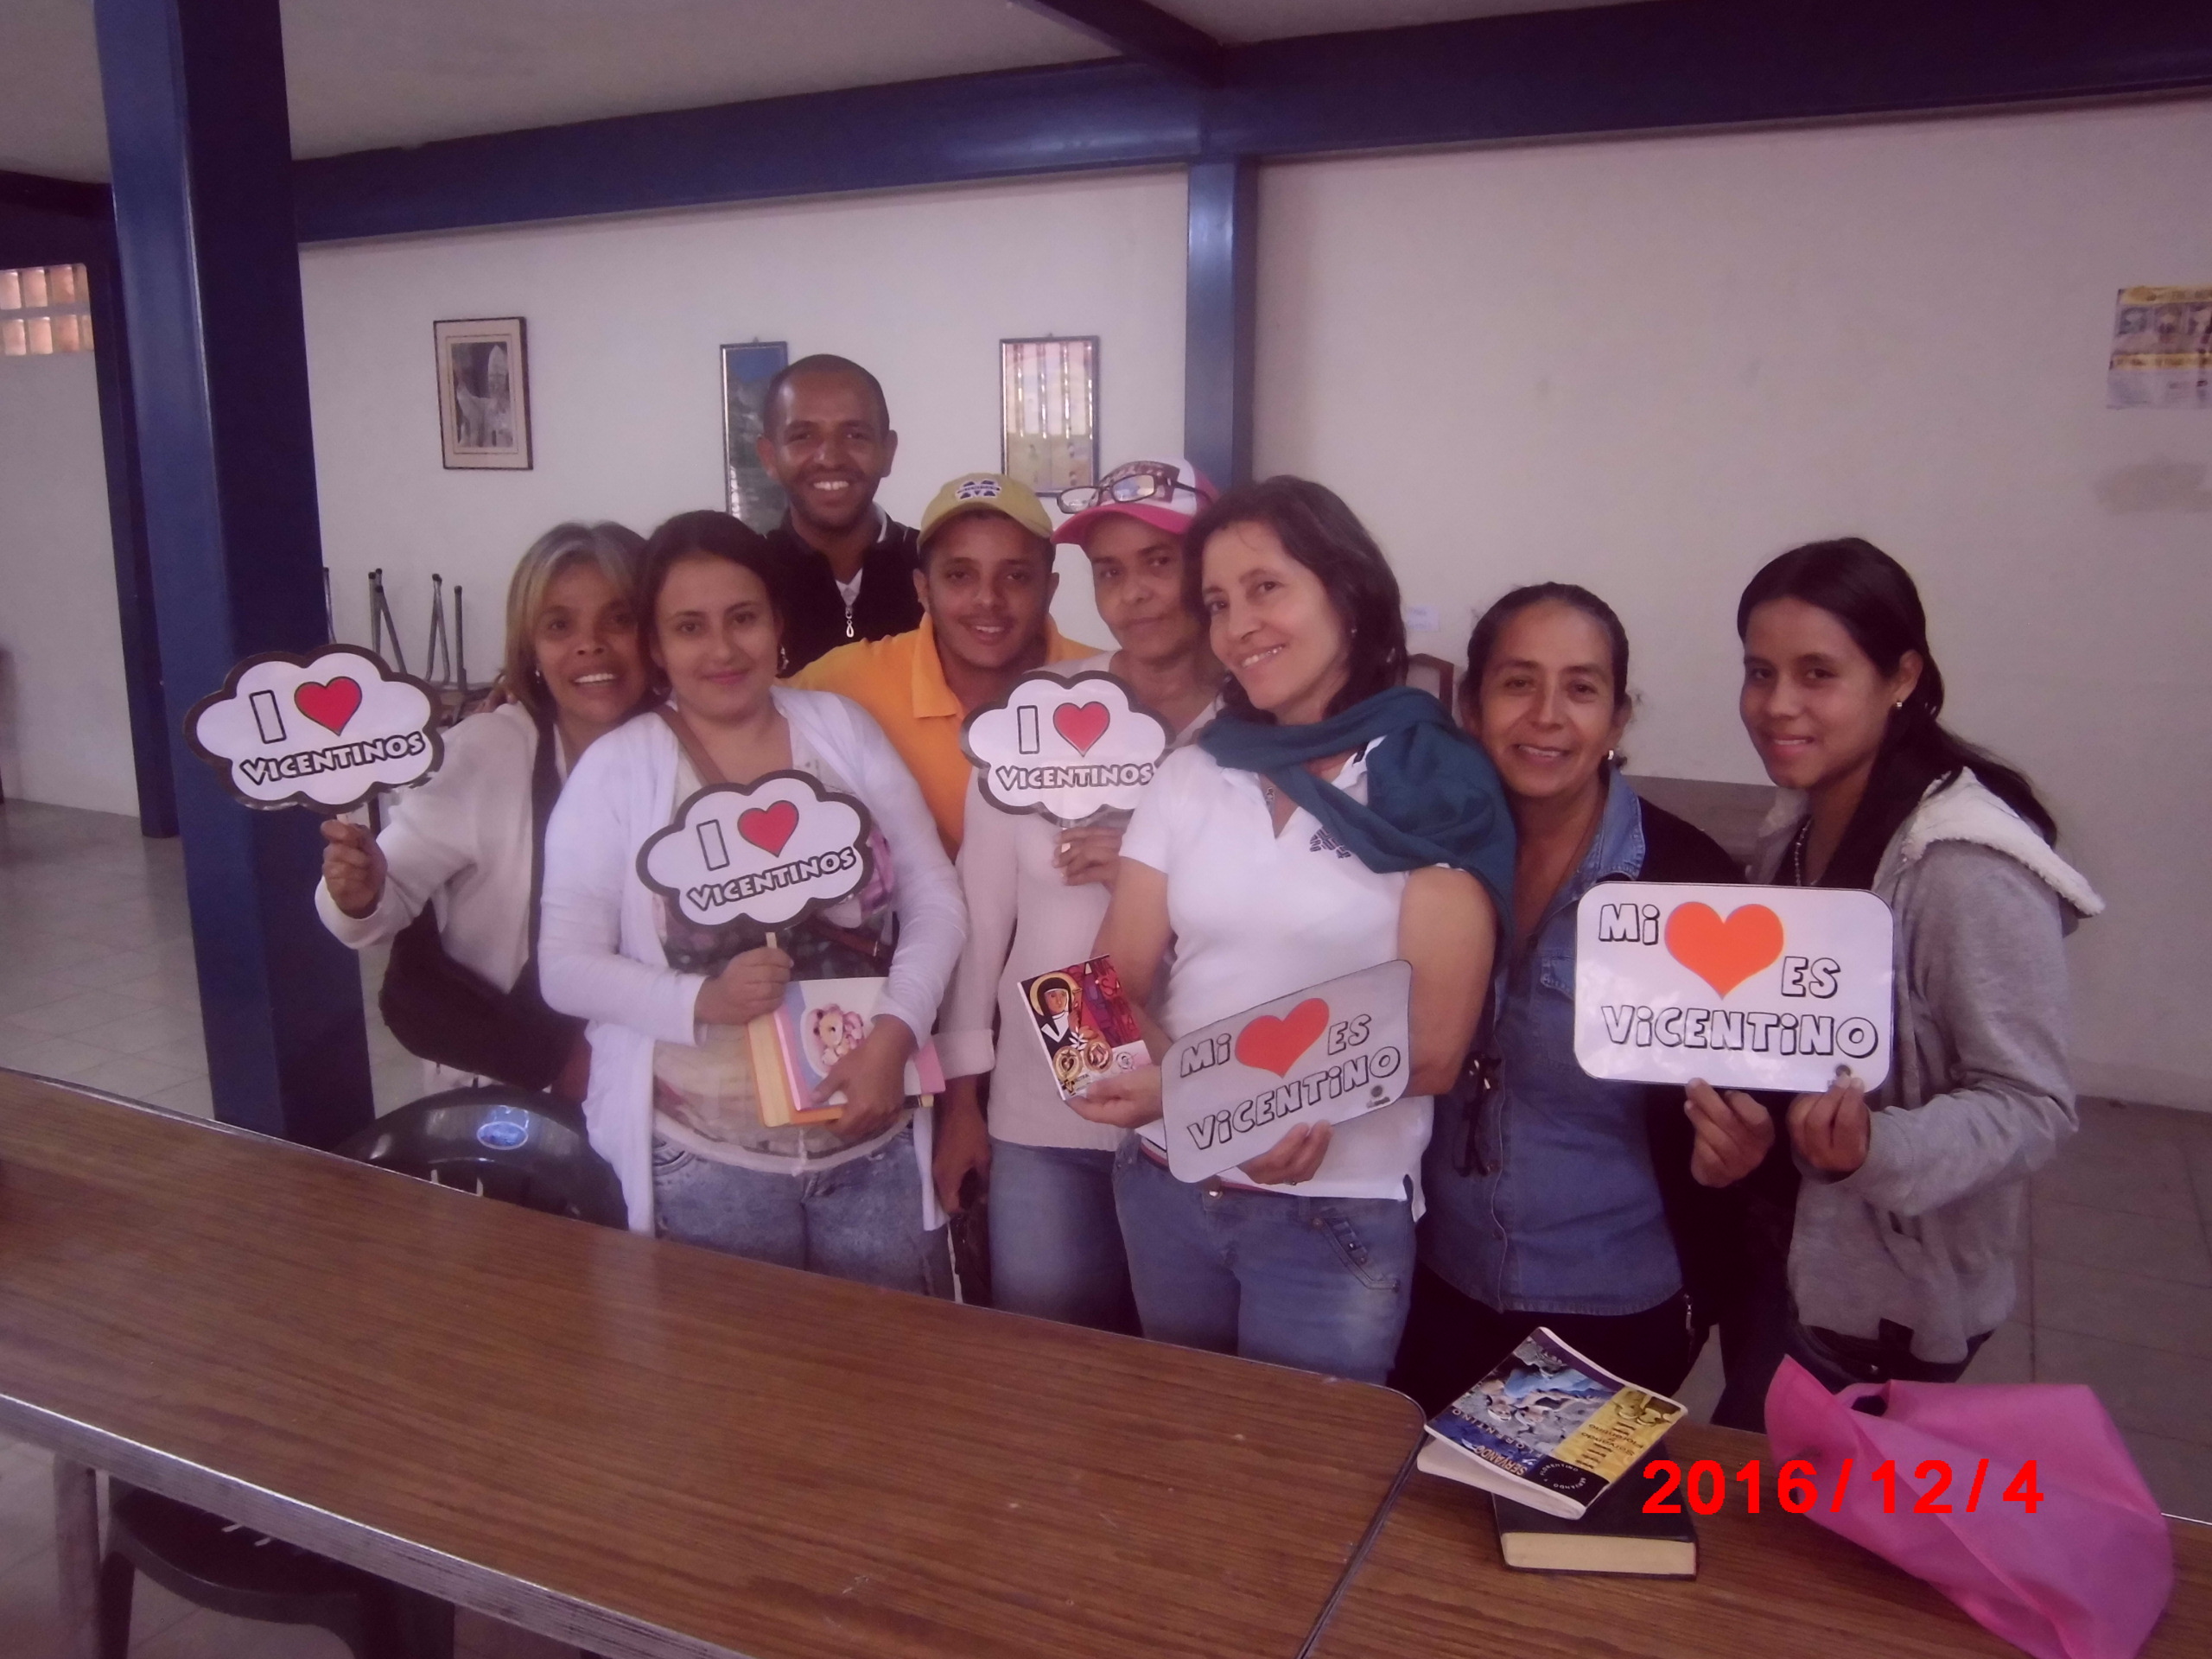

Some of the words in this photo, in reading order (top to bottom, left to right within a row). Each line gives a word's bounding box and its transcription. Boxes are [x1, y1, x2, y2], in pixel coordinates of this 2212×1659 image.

[249, 690, 287, 744] I
[1017, 705, 1039, 754] I
[239, 731, 425, 785] VICENTINOS
[995, 763, 1155, 791] VICENTINOS
[696, 819, 730, 871] I
[686, 846, 856, 912] VICENTINOS
[1599, 903, 1660, 945] Mi
[1781, 956, 1840, 999] ES
[1180, 1033, 1232, 1077] Mi
[1327, 1014, 1371, 1055] ES
[1452, 1408, 1543, 1458] FLORENTINO
[1581, 1432, 1635, 1456] Servando
[1588, 1424, 1644, 1448] Florentino
[1474, 1445, 1528, 1476] SERVANDO
